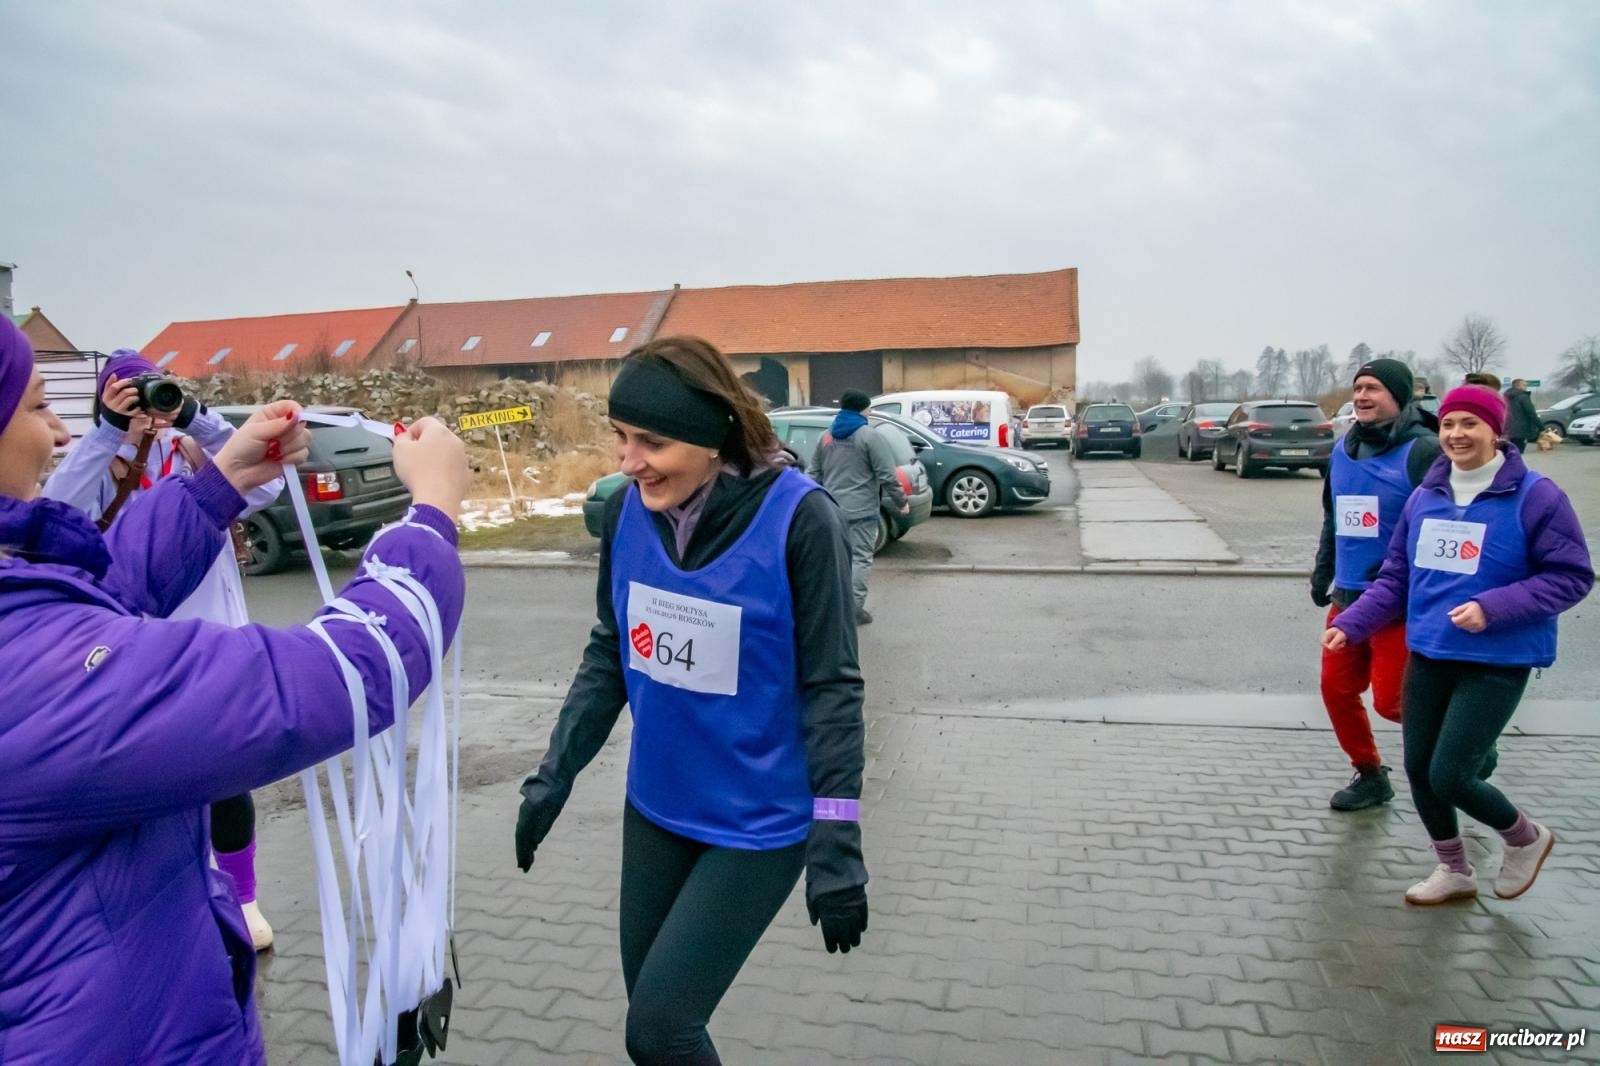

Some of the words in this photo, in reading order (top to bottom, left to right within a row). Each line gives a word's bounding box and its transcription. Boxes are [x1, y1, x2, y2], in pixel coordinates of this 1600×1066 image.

[460, 410, 515, 428] PARKING
[950, 426, 988, 438] Catering
[1344, 511, 1361, 527] 65
[1434, 538, 1459, 559] 33
[658, 599, 675, 609] BIEG
[656, 632, 696, 671] 64
